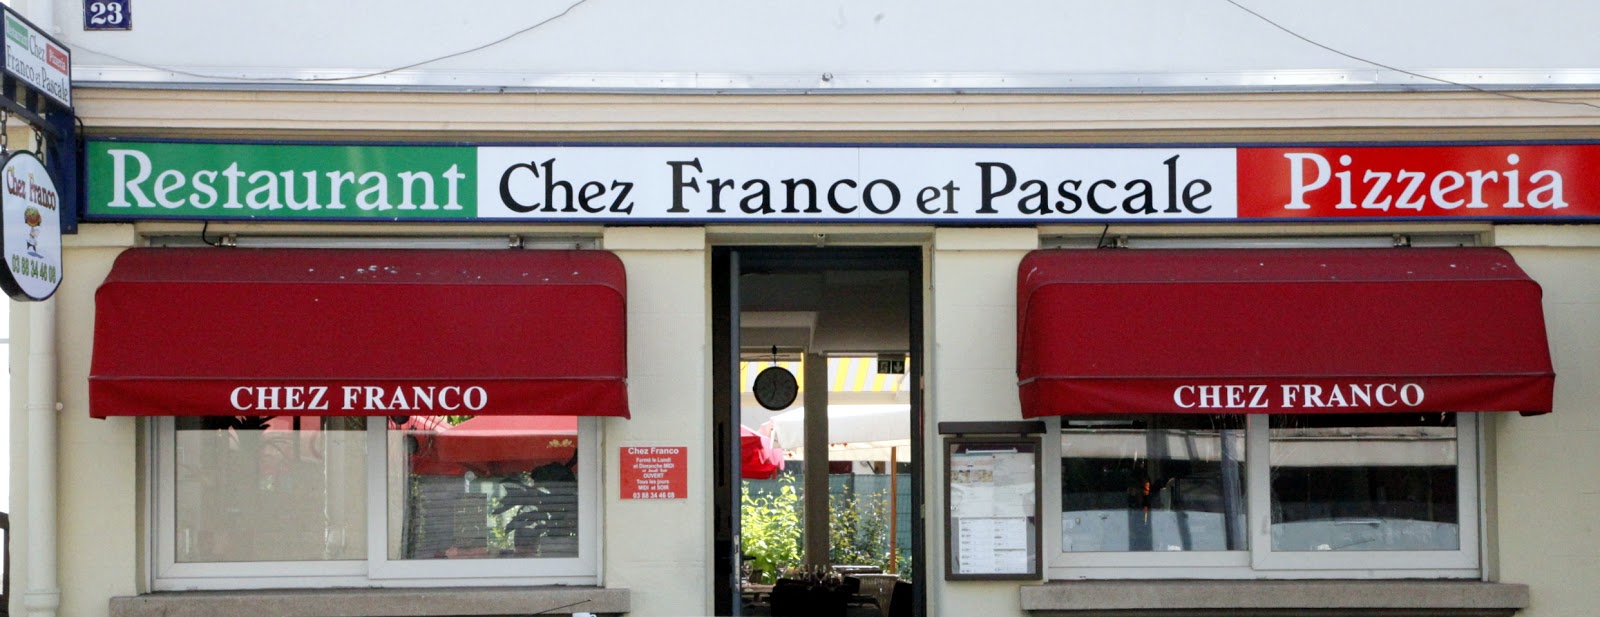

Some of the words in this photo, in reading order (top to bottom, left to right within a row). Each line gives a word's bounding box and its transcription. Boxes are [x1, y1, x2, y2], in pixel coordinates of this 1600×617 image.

[90, 2, 123, 25] 23
[30, 35, 45, 61] Chez
[6, 44, 34, 81] Franco
[41, 66, 69, 103] Pascale
[6, 166, 26, 200] Chez
[28, 172, 57, 211] Franco
[107, 149, 465, 212] Restaurant
[498, 158, 634, 215] Chez
[667, 158, 901, 215] Franco
[916, 180, 960, 215] et
[975, 154, 1213, 215] Pascale
[1283, 152, 1568, 210] Pizzeria
[11, 254, 20, 274] 03
[30, 260, 39, 279] 34
[230, 386, 330, 411] CHEZ
[341, 386, 488, 411] FRANCO
[1173, 385, 1269, 409] CHEZ
[1280, 383, 1425, 407] FRANCO
[628, 447, 649, 455] Chez
[650, 447, 679, 455] Franco
